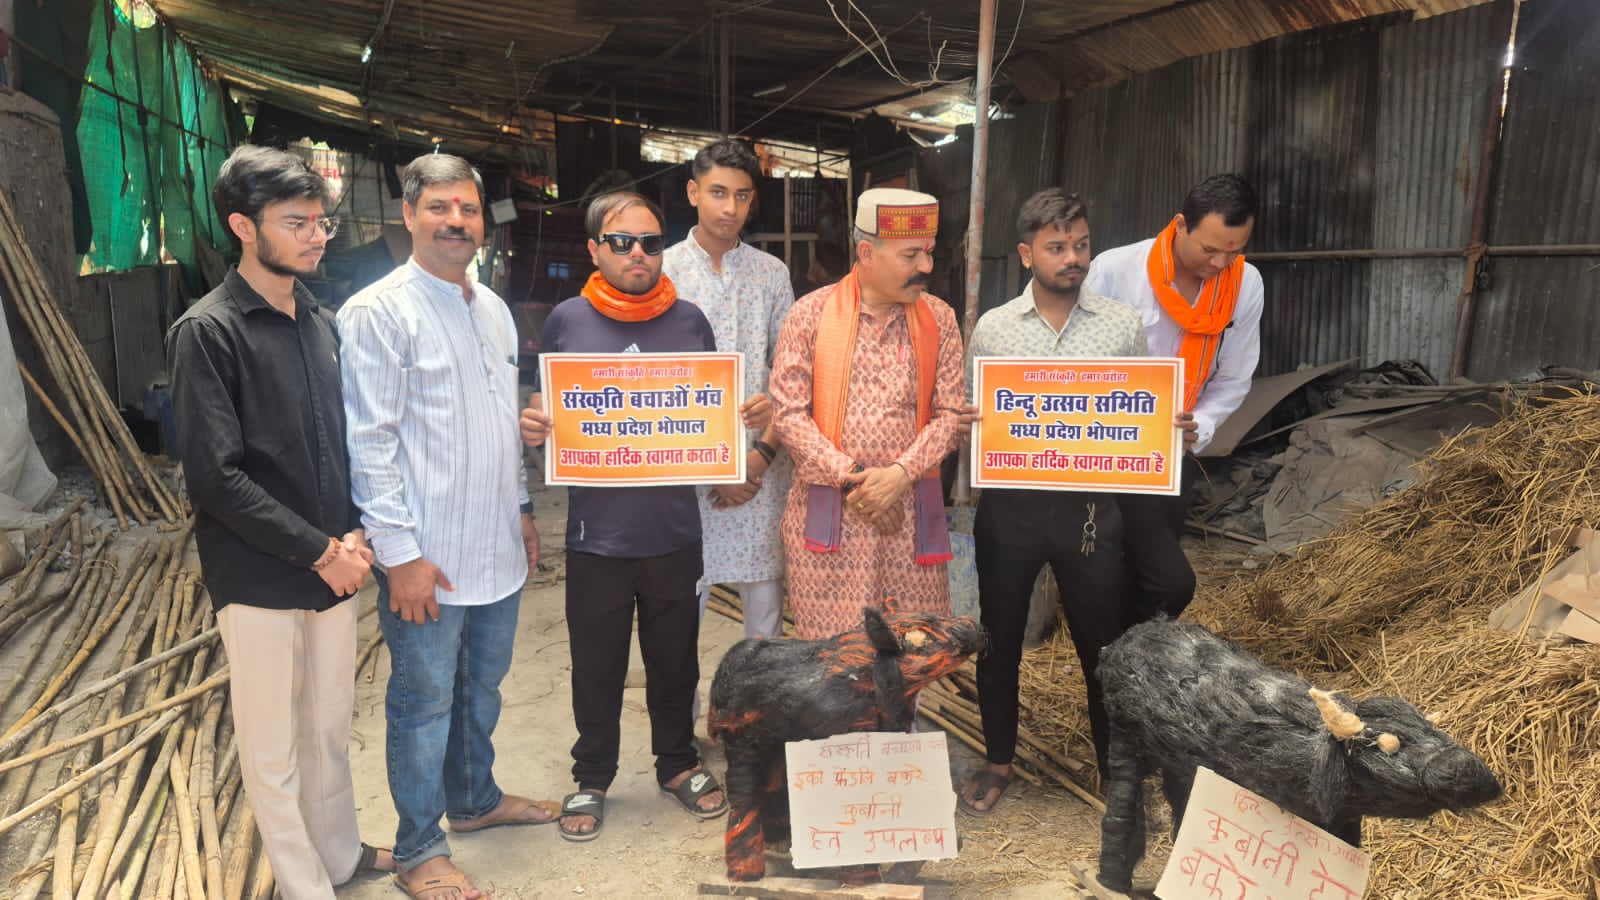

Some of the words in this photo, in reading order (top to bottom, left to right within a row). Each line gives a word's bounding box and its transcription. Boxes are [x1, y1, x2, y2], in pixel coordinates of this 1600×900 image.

[562, 386, 624, 414] संस्कृति
[630, 384, 690, 408] बचाओं
[695, 384, 722, 407] मंच
[996, 390, 1037, 417] हिन्दू
[1041, 394, 1088, 413] उत्सव
[1095, 391, 1156, 413] समिति
[582, 421, 611, 436] मध्य
[617, 417, 653, 436] प्रदेश
[658, 416, 705, 435] भोपाल
[1010, 423, 1039, 438] मध्य
[1046, 420, 1081, 439] प्रदेश
[1088, 421, 1138, 440] भोपाल
[561, 449, 600, 466] आपका
[605, 446, 642, 466] हार्दिक
[646, 448, 683, 465] स्वागत
[688, 447, 717, 464] करता
[720, 444, 729, 462] है
[986, 452, 1027, 468] आपका
[1032, 450, 1069, 470] हार्दिक
[1073, 454, 1112, 471] स्वागत
[1117, 455, 1150, 472] करता
[1154, 452, 1164, 472] है
